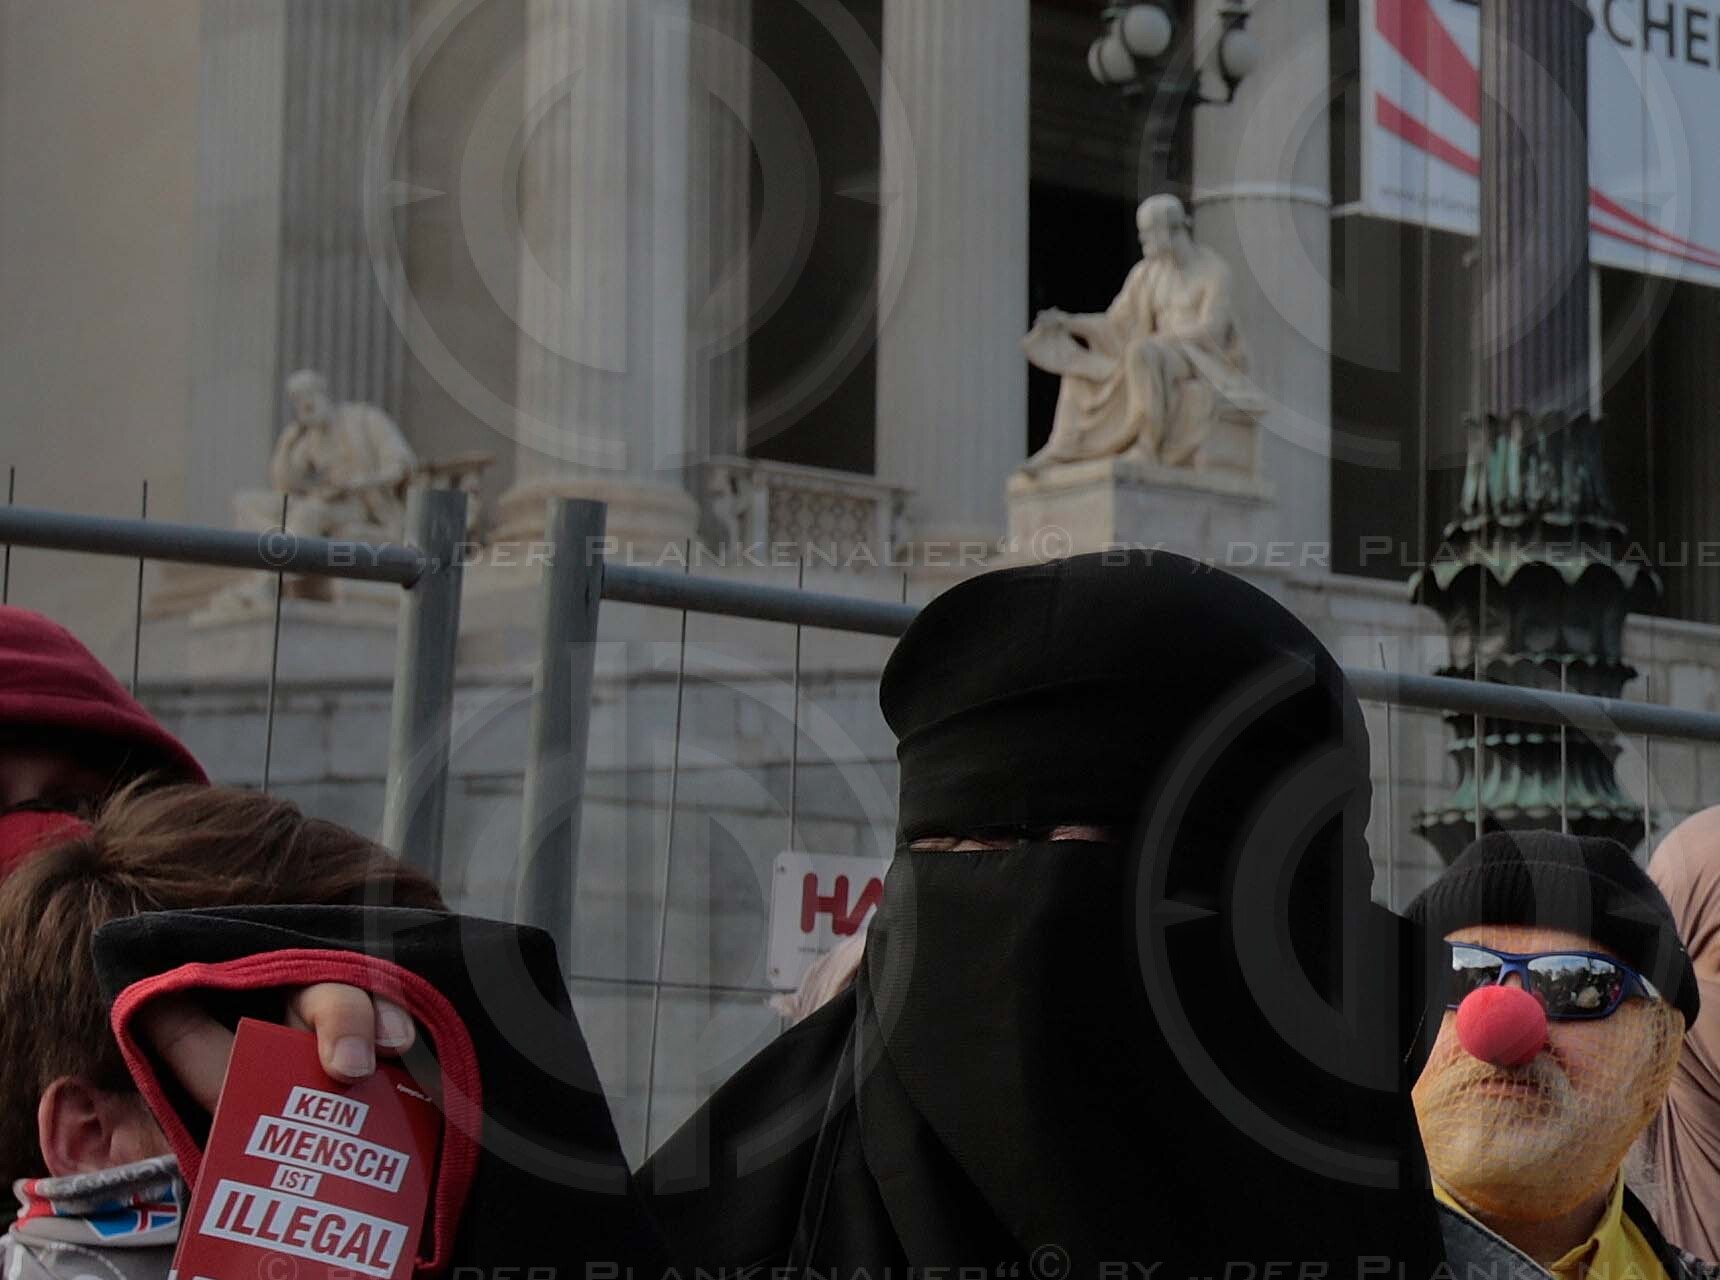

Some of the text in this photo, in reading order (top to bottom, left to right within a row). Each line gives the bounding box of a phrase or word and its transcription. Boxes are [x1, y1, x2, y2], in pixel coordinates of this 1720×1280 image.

[293, 1092, 360, 1129] KEIN
[257, 1123, 401, 1186] MENSCH
[278, 1169, 315, 1192] IST
[214, 1190, 394, 1271] ILLEGAL
